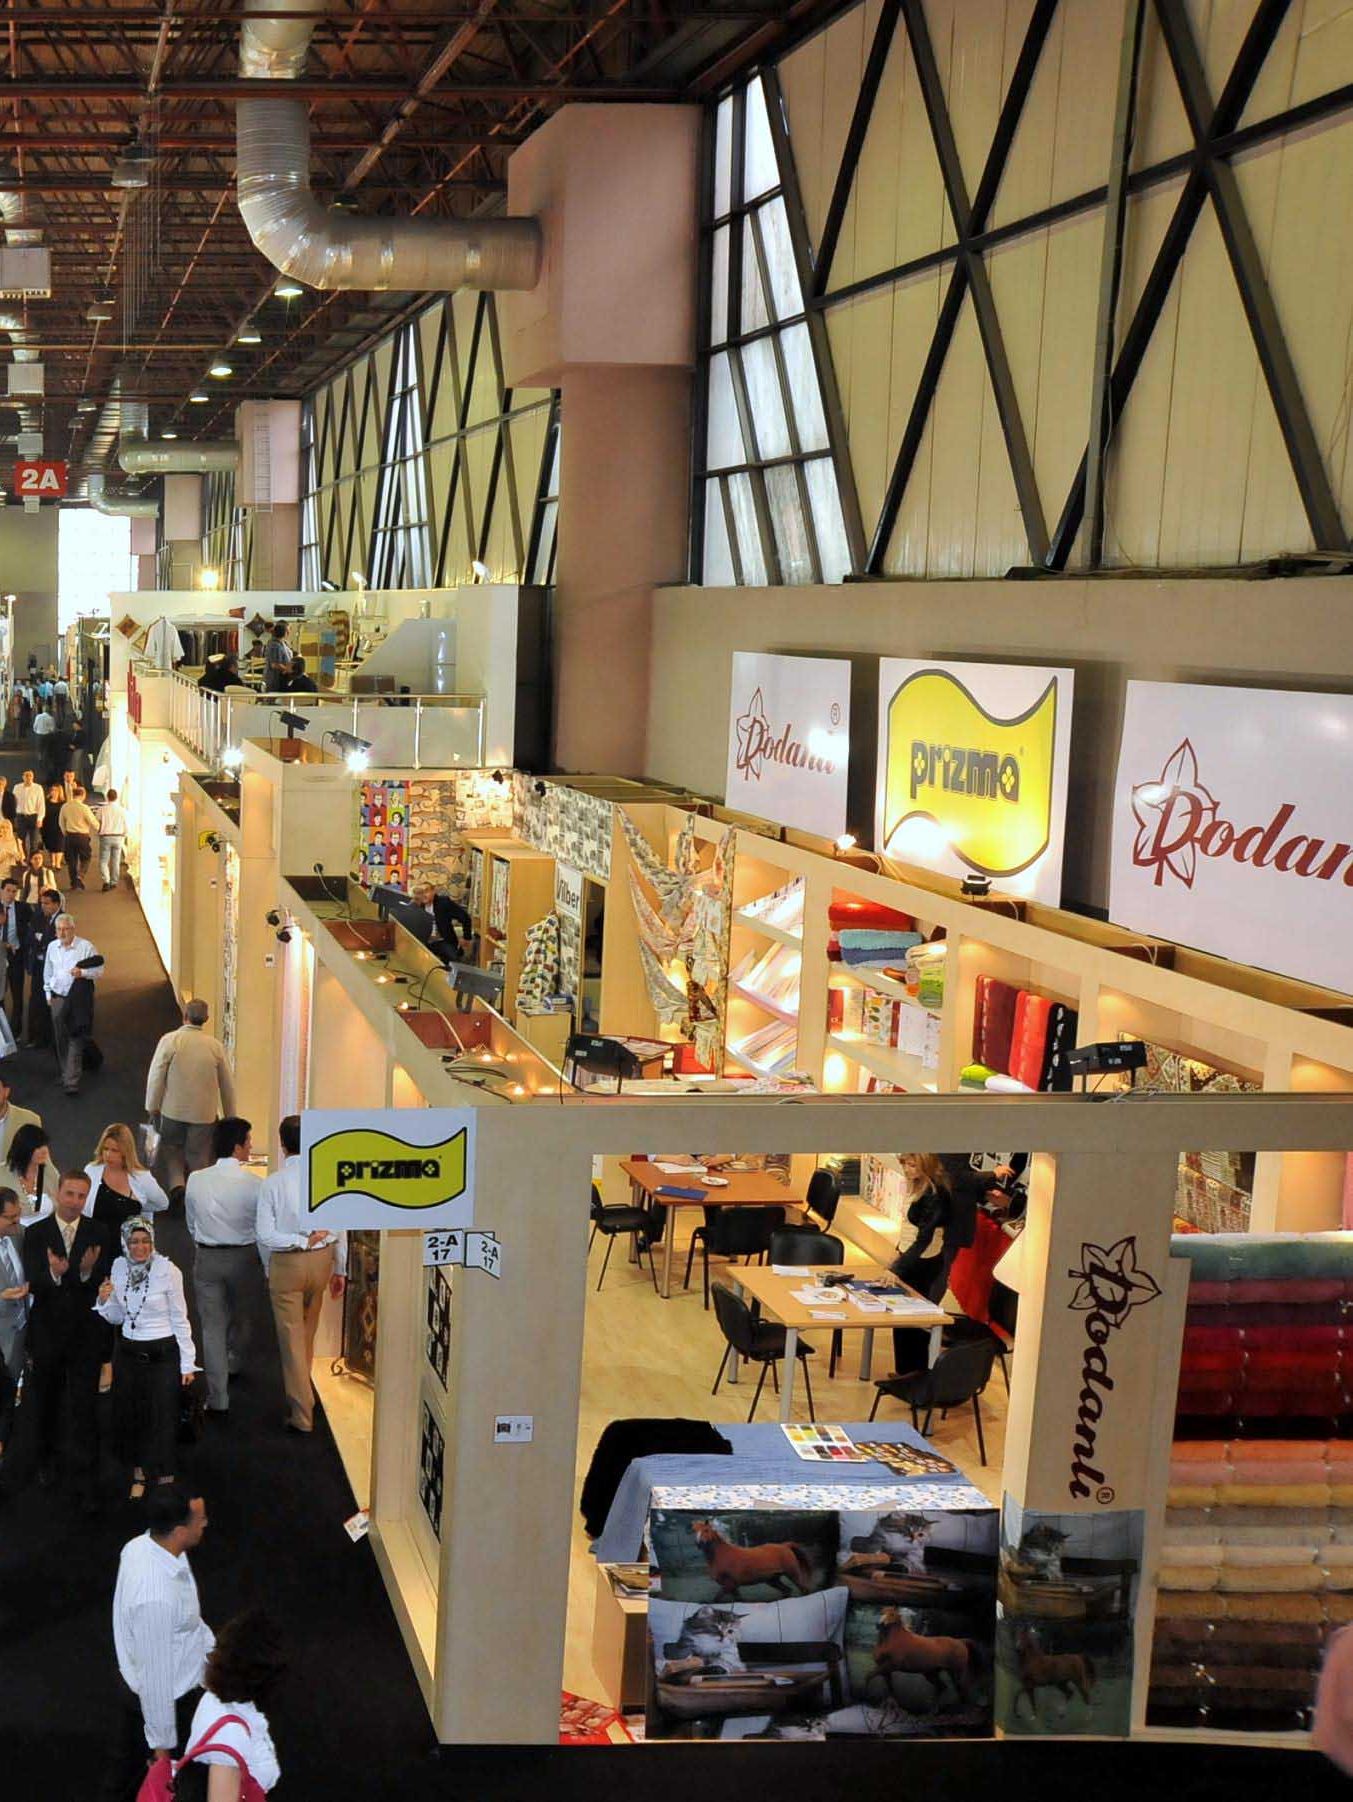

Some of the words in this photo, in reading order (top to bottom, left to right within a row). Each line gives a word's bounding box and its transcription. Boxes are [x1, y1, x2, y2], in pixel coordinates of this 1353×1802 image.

[21, 468, 60, 490] 2A
[737, 716, 835, 774] Dodan
[909, 739, 1021, 804] prizma
[1149, 785, 1353, 887] Dodan
[336, 1158, 441, 1188] prizma
[428, 1234, 458, 1249] 2-A
[481, 1240, 499, 1260] 2-A
[432, 1249, 450, 1261] 17
[483, 1256, 494, 1270] 17
